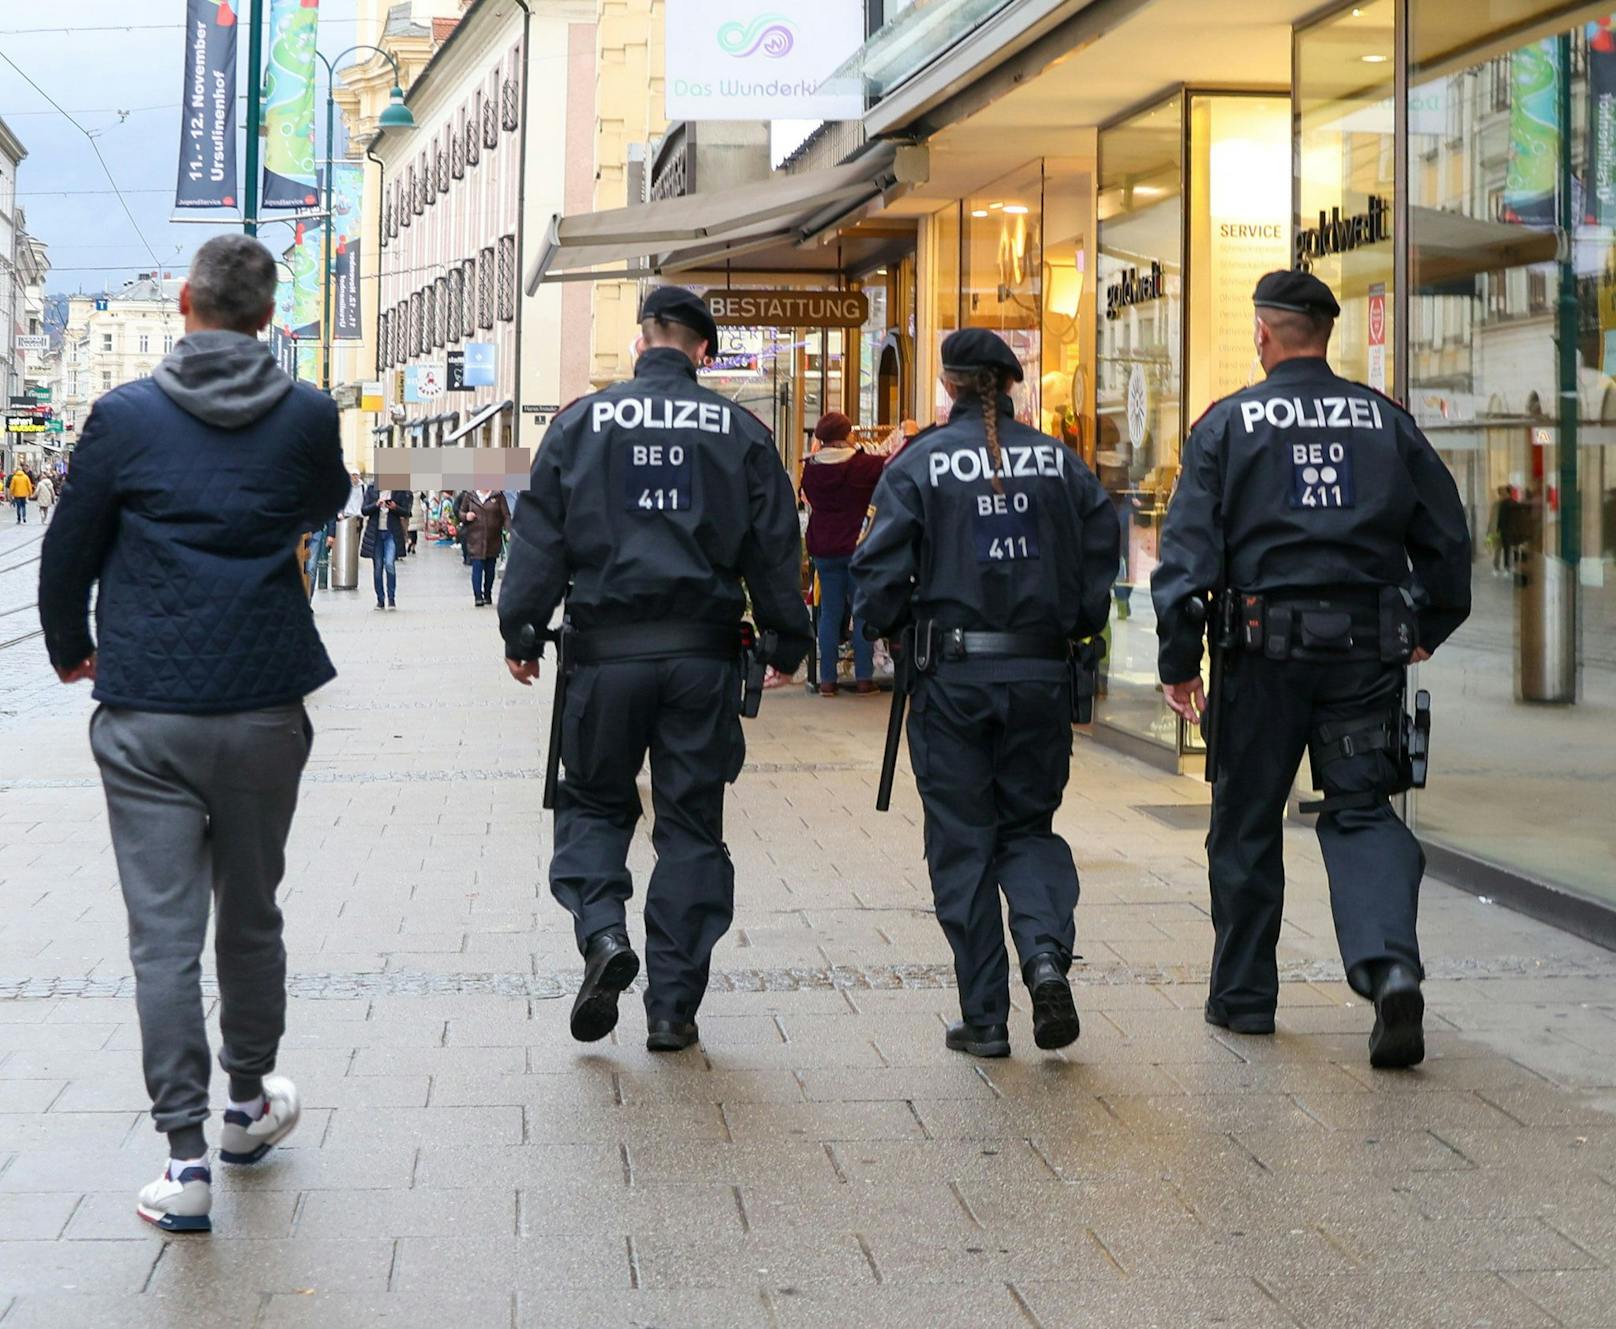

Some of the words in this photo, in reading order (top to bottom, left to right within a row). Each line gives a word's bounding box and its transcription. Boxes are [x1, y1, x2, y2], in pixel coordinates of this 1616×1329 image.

[192, 21, 207, 108] November
[674, 79, 712, 97] Das
[720, 79, 818, 97] Wunderki
[190, 112, 204, 139] 12.
[211, 70, 225, 182] Ursulinenhof
[189, 155, 203, 181] 11.
[1220, 223, 1281, 239] SERVICE
[709, 297, 860, 319] BESTATTUNG
[592, 397, 731, 435] POLIZEI
[1240, 396, 1384, 433] POLIZEI
[633, 445, 663, 466] BE
[1292, 443, 1324, 465] BE
[929, 445, 1065, 488] POLIZEI
[638, 488, 678, 510] 411
[976, 494, 1008, 516] BE
[1302, 485, 1342, 508] 411
[989, 536, 1029, 560] 411
